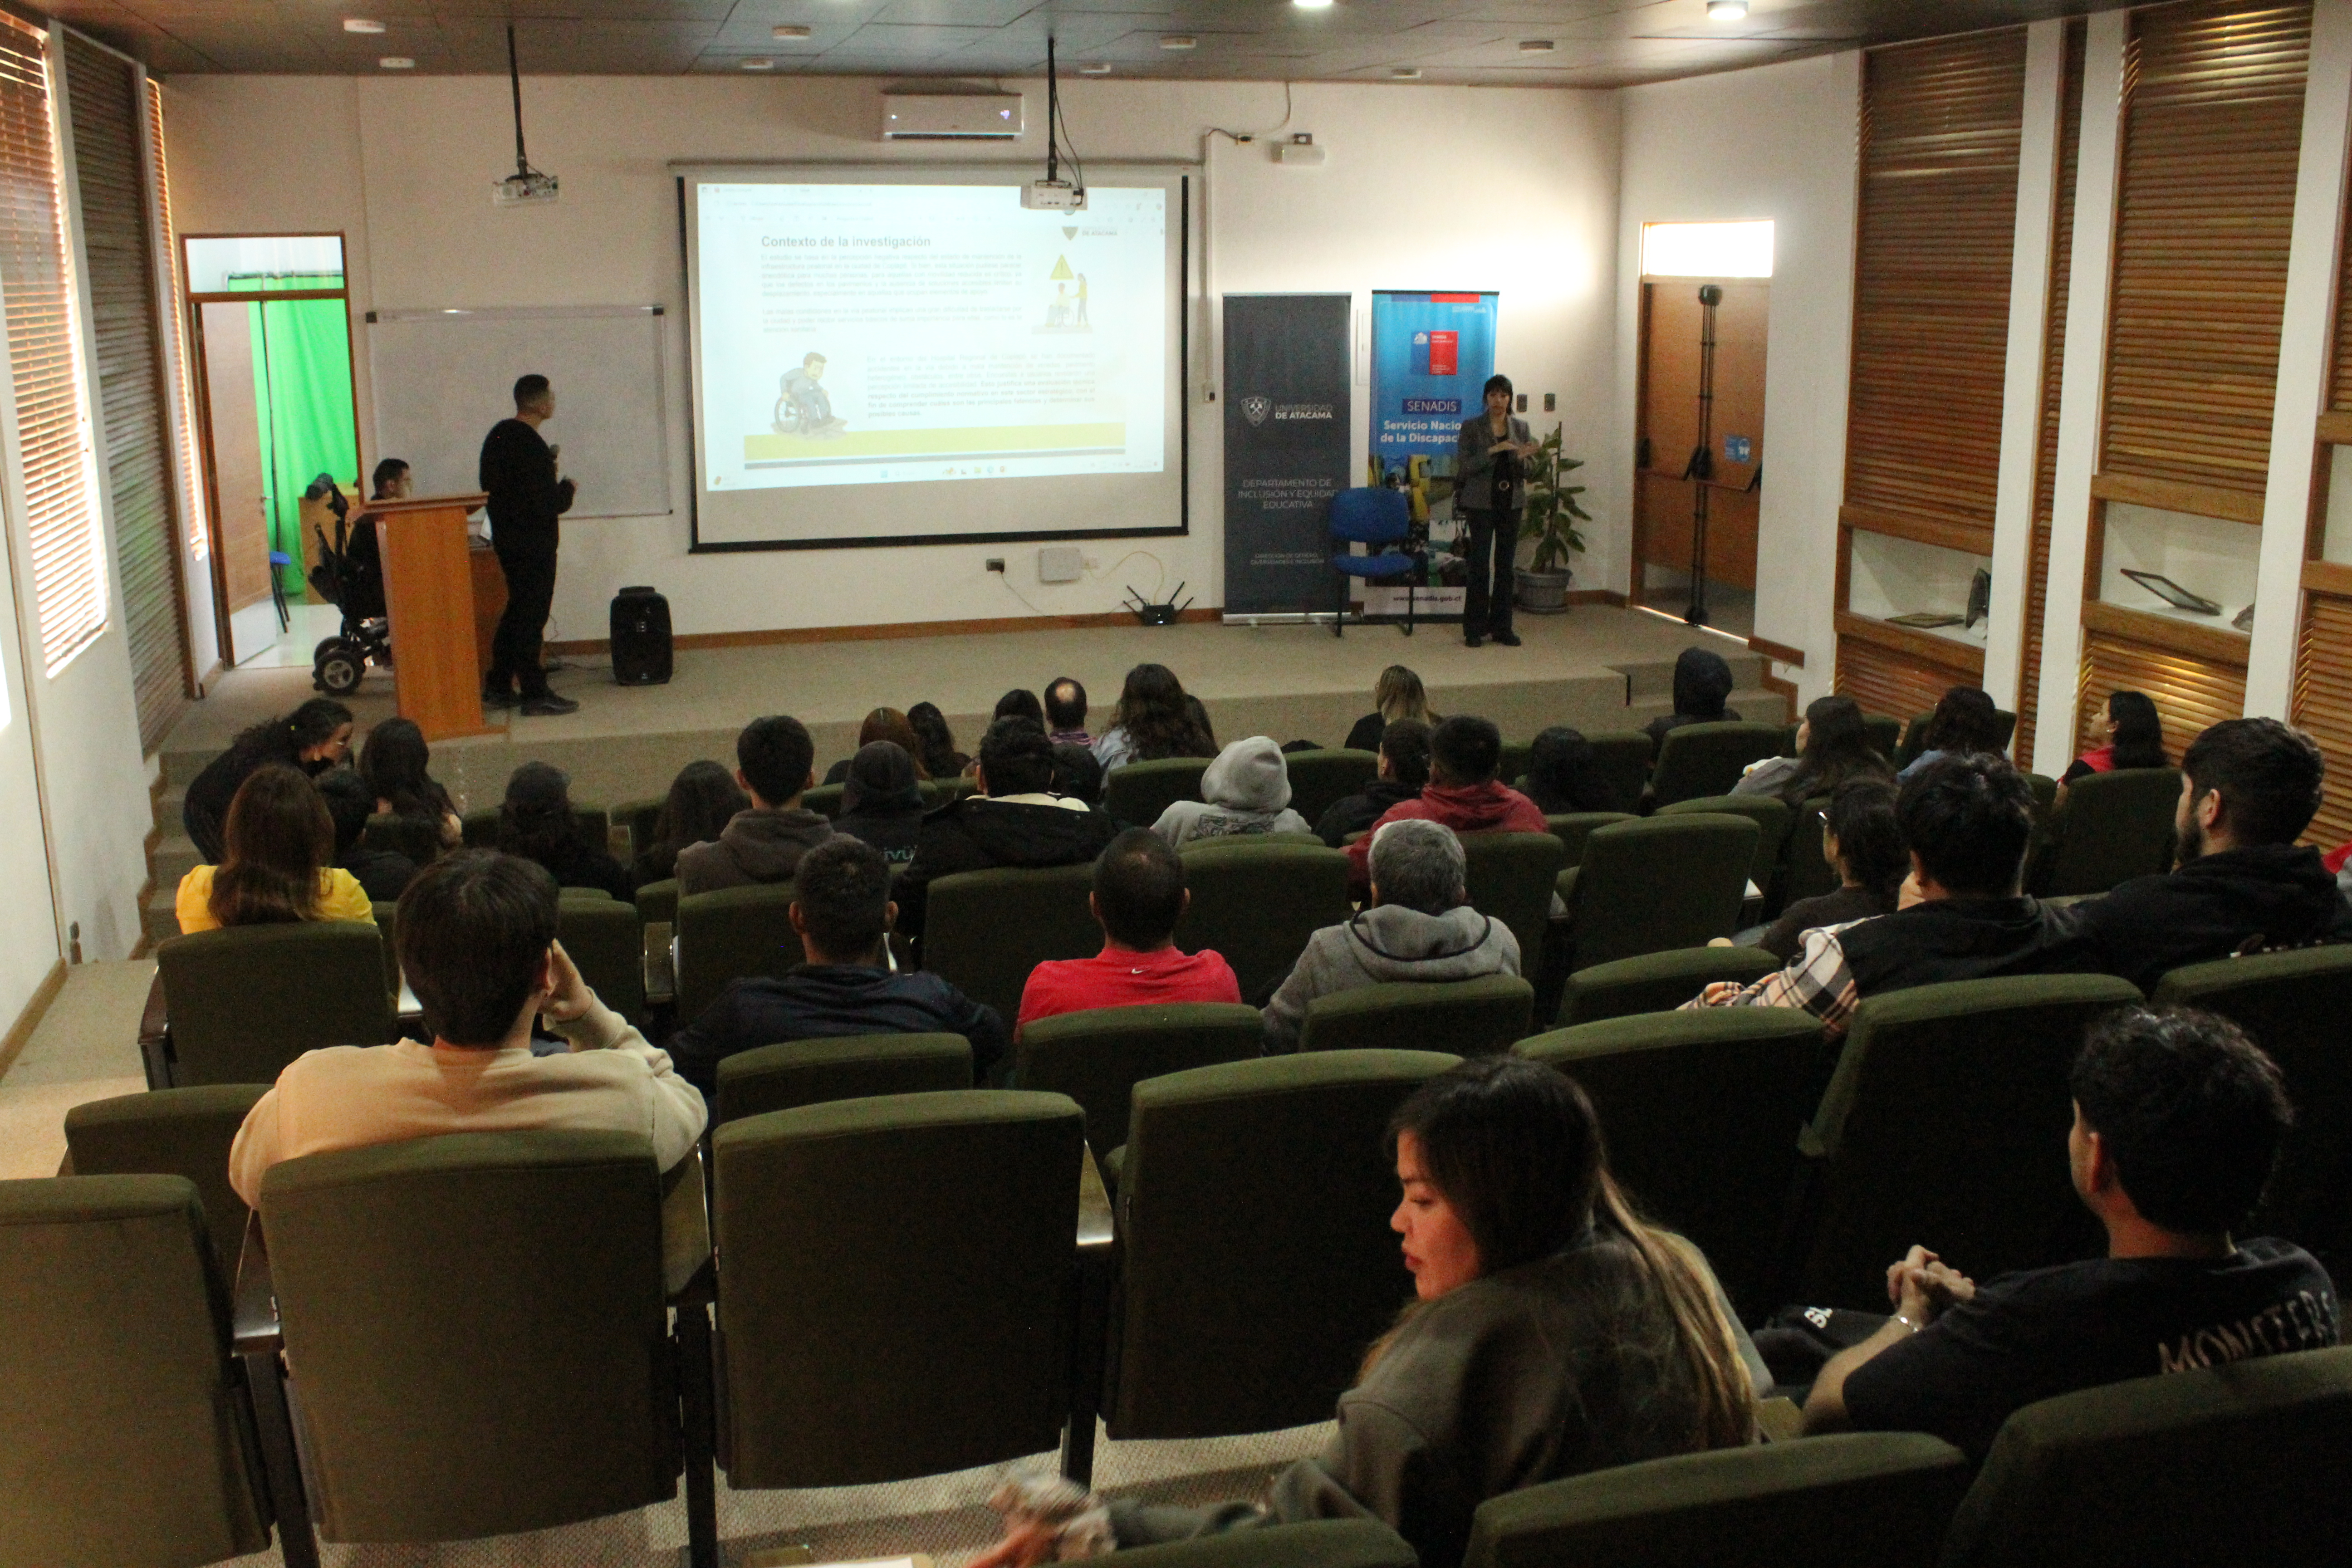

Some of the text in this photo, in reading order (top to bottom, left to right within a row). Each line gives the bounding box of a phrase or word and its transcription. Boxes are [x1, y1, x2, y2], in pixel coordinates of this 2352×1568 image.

[761, 236, 931, 249] Contexto de la investigación
[1407, 401, 1457, 412] SENADIS
[1384, 420, 1462, 430] Servicio Nacio
[1380, 433, 1459, 444] de la Discapac
[1243, 479, 1317, 487] DEPARTAMENTO
[1263, 501, 1313, 509] EDUCATIVA
